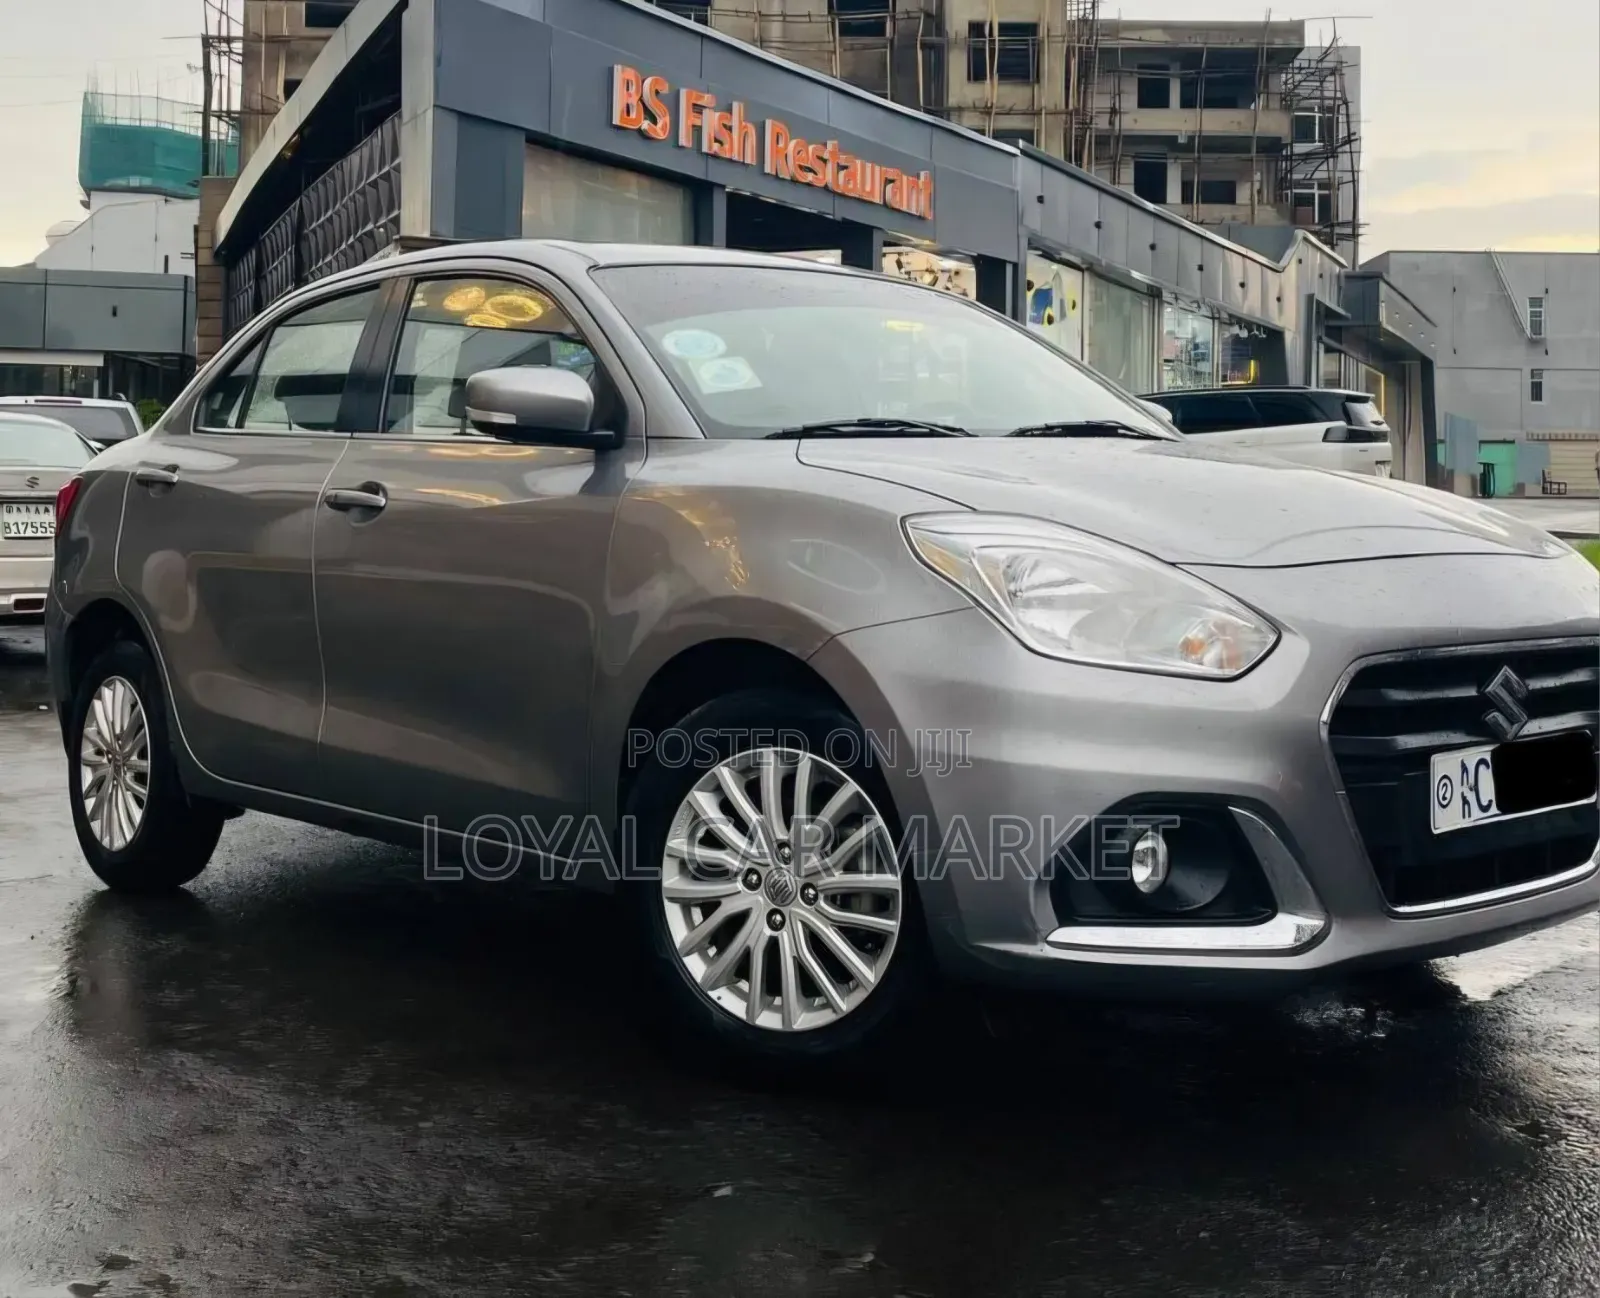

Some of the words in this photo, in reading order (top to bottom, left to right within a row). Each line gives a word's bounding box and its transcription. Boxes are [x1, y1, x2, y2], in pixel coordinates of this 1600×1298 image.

[612, 64, 670, 140] BS
[678, 87, 757, 166] Fish
[764, 118, 934, 220] Restaurant
